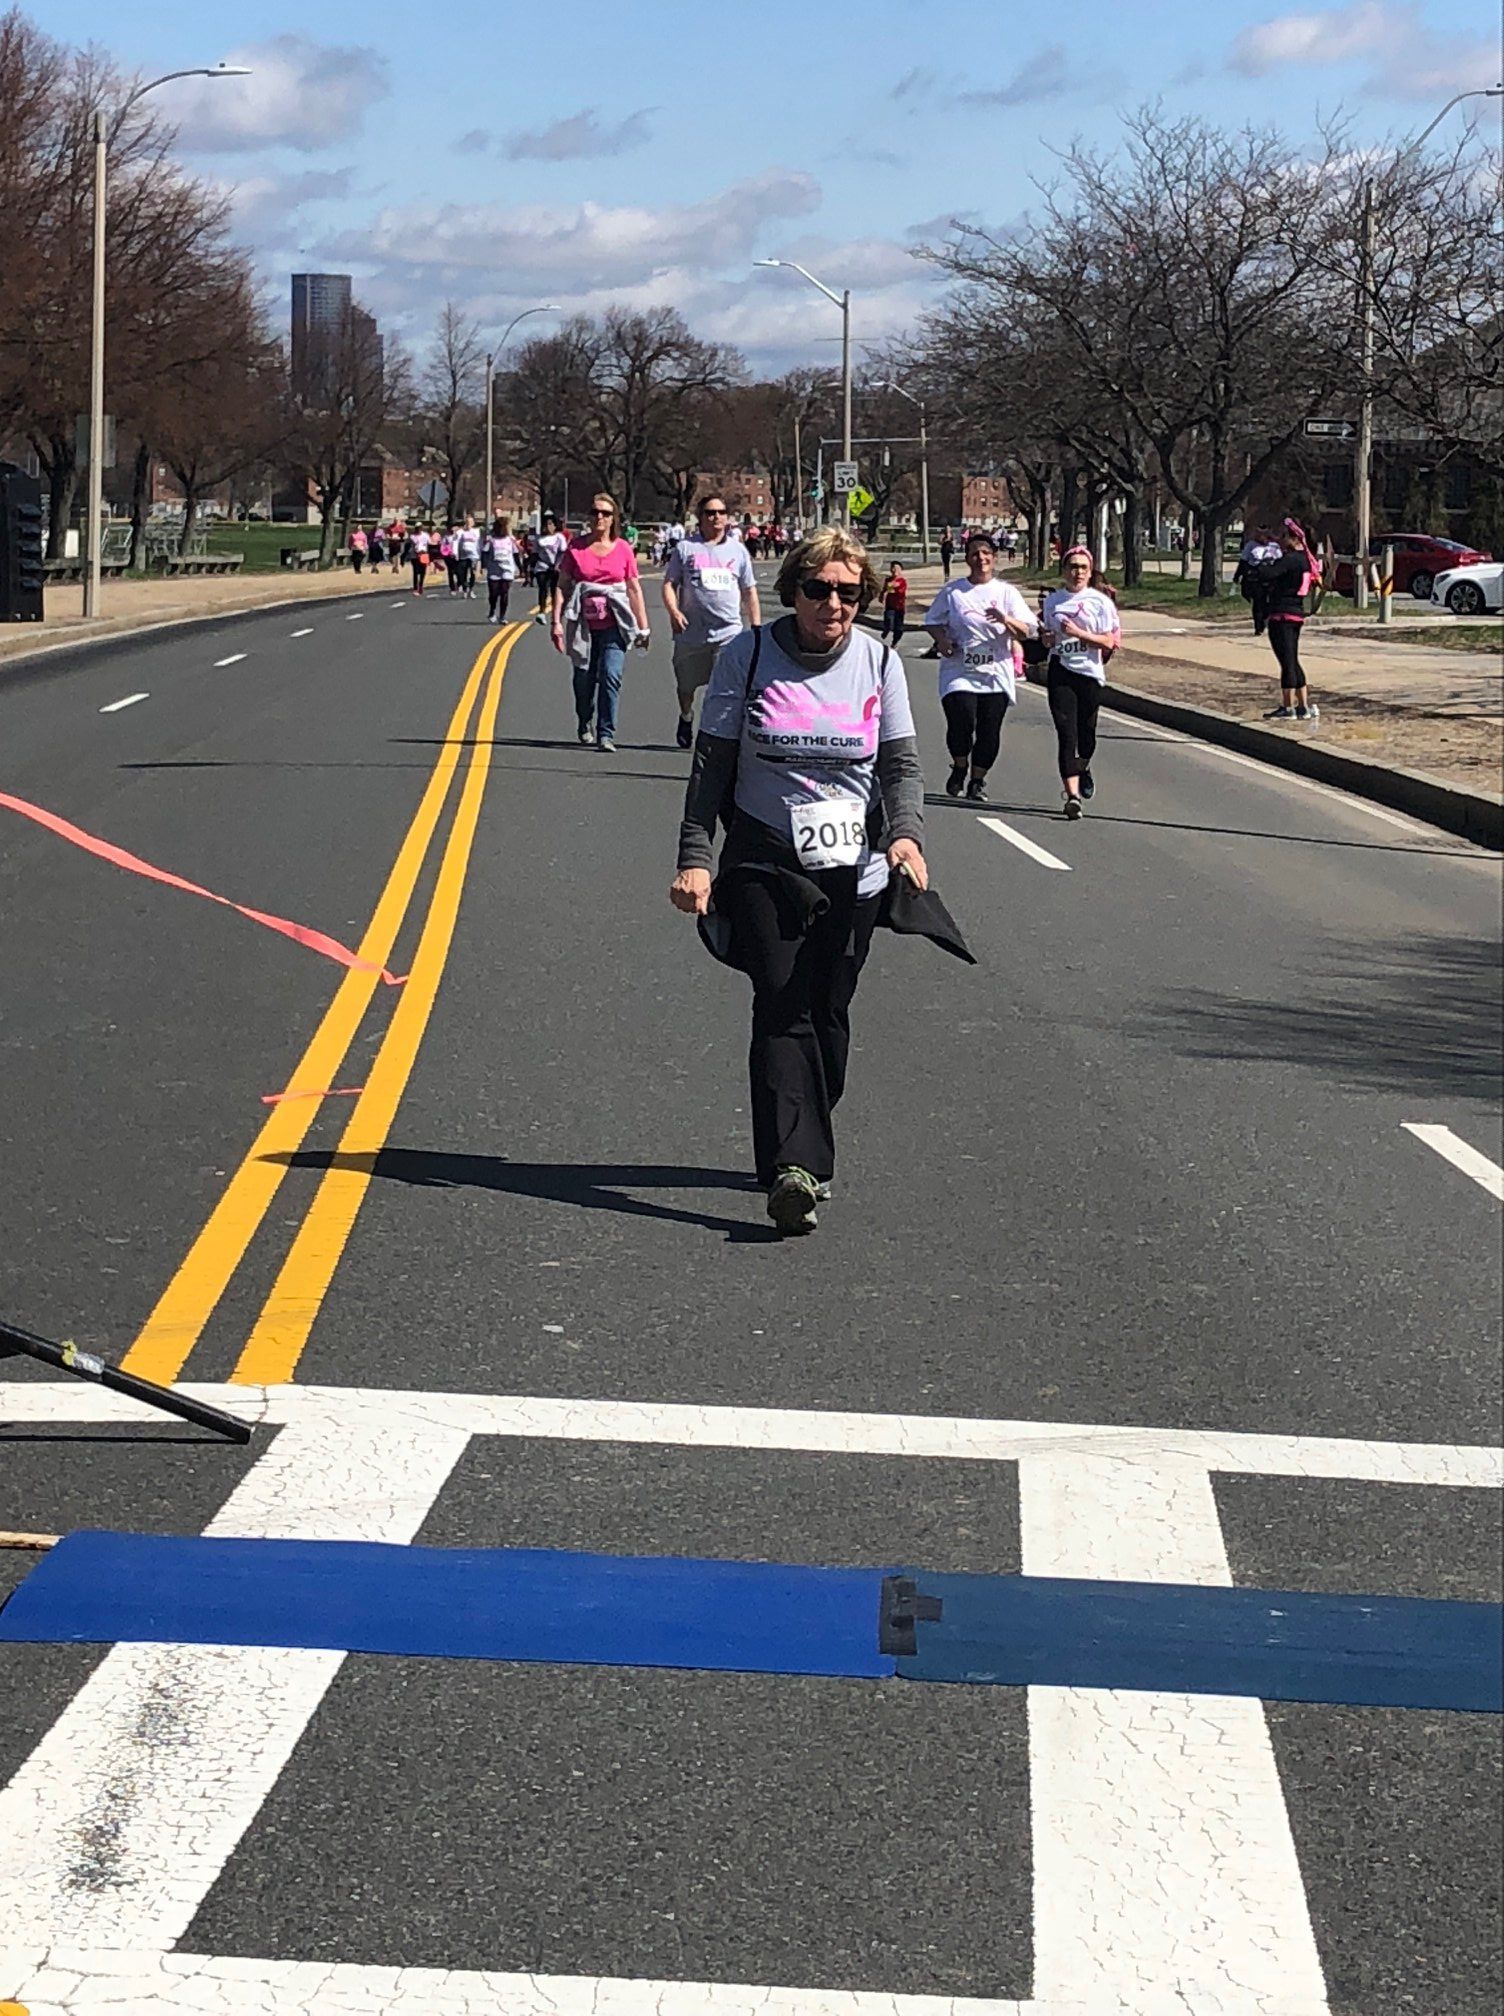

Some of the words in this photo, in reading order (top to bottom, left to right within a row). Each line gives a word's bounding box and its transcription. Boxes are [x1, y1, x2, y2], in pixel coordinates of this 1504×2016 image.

[837, 477, 856, 488] 30
[772, 735, 799, 746] FOR
[802, 736, 827, 746] THE
[831, 737, 864, 747] CURE
[799, 821, 865, 853] 2018
